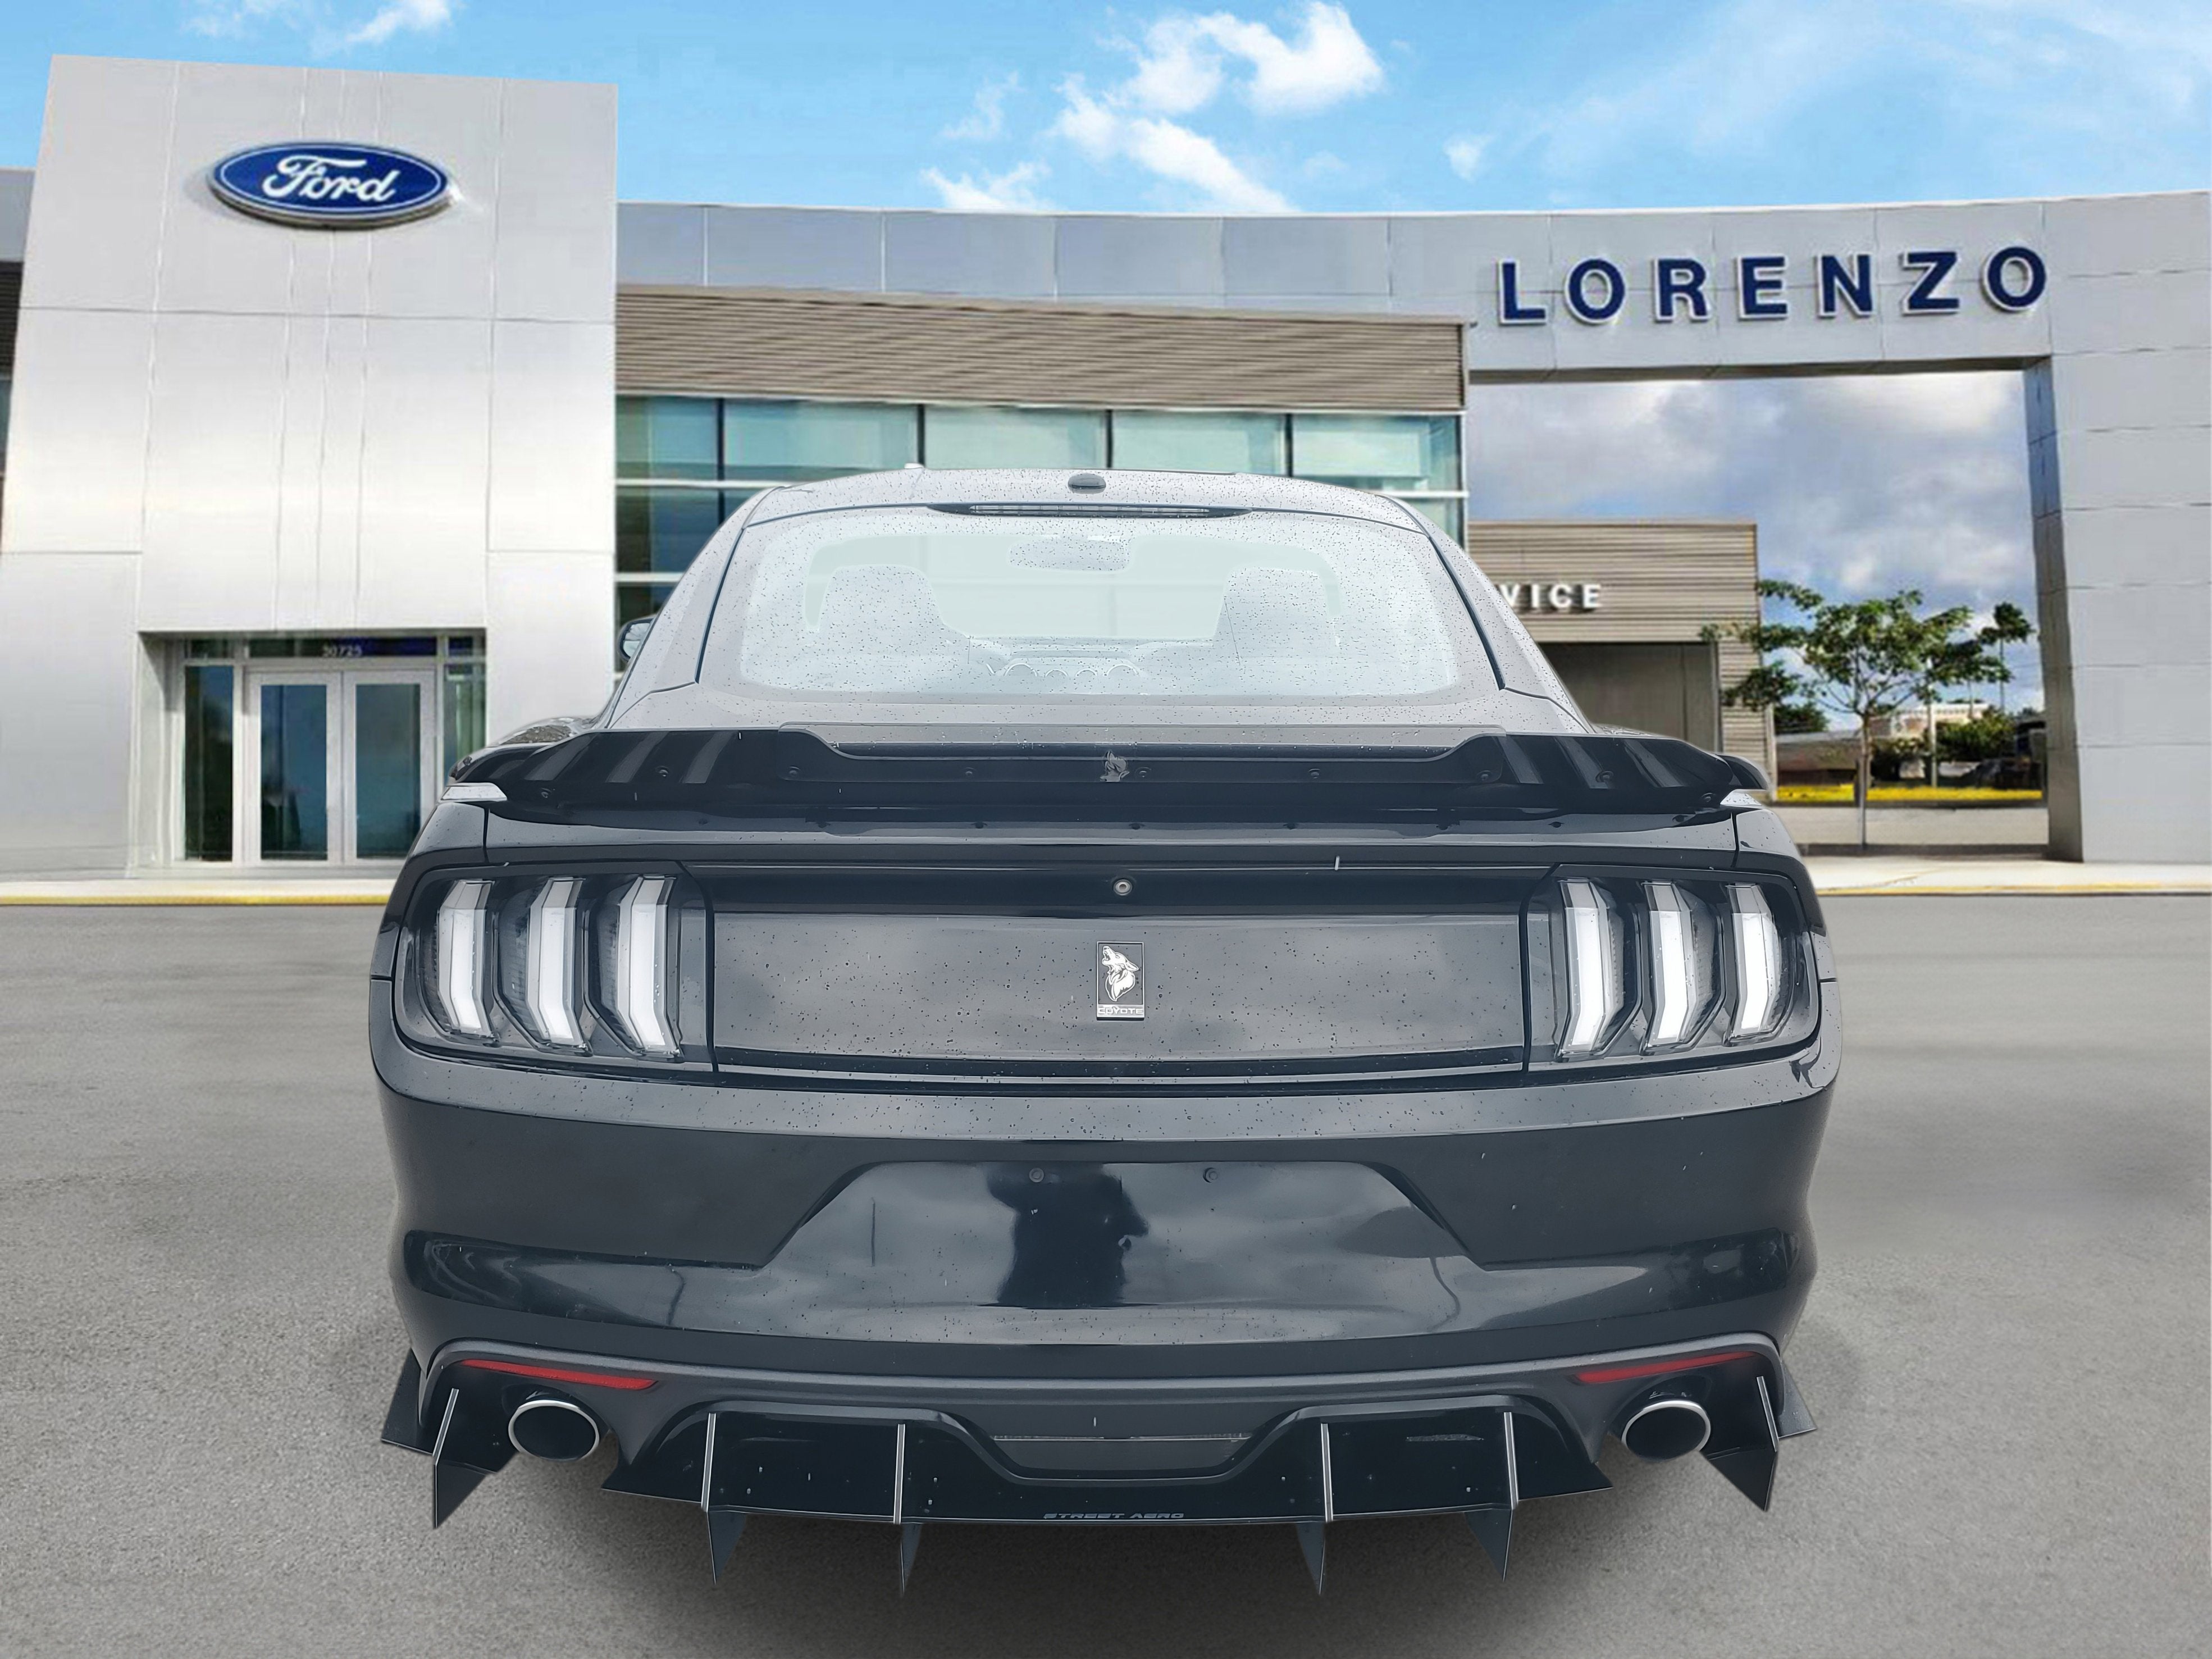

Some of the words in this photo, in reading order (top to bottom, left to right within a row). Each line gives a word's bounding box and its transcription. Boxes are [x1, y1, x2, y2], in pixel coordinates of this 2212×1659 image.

[262, 155, 400, 202] Ford
[1499, 246, 2047, 325] LORENZO
[1098, 1005, 1143, 1015] COYOTE
